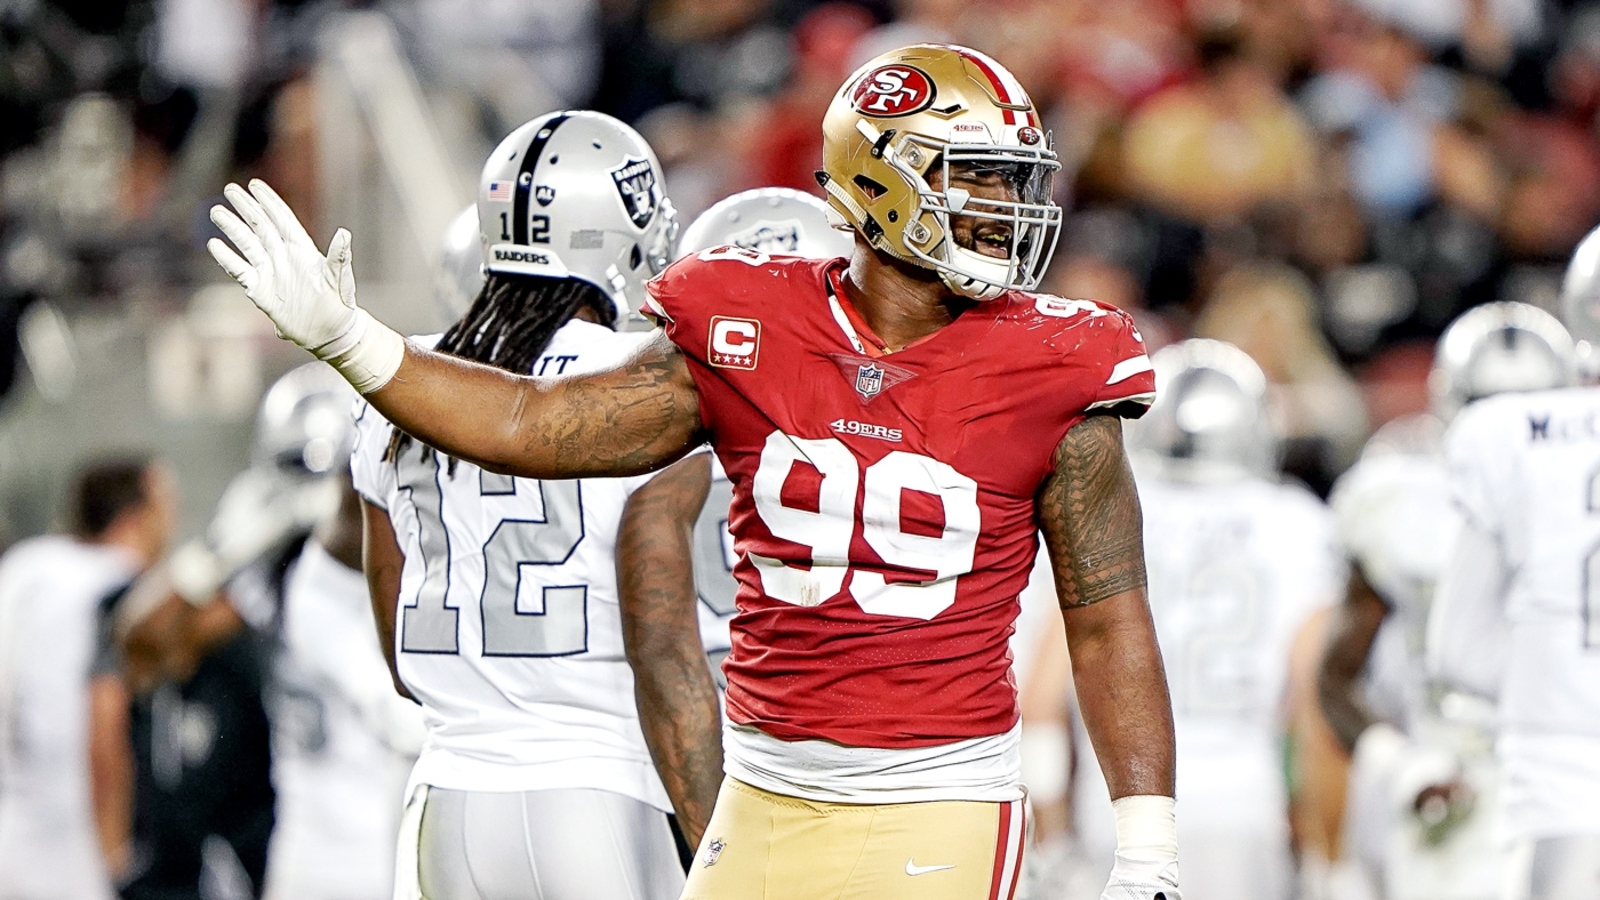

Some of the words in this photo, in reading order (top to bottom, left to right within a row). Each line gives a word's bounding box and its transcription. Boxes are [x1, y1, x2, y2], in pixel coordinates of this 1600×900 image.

[614, 161, 650, 181] RAIDERS
[495, 250, 550, 265] RAIDERS
[712, 320, 757, 356] C
[860, 376, 878, 391] NFL
[830, 418, 903, 442] 49ERS
[748, 429, 981, 621] 99
[397, 432, 589, 658] 12
